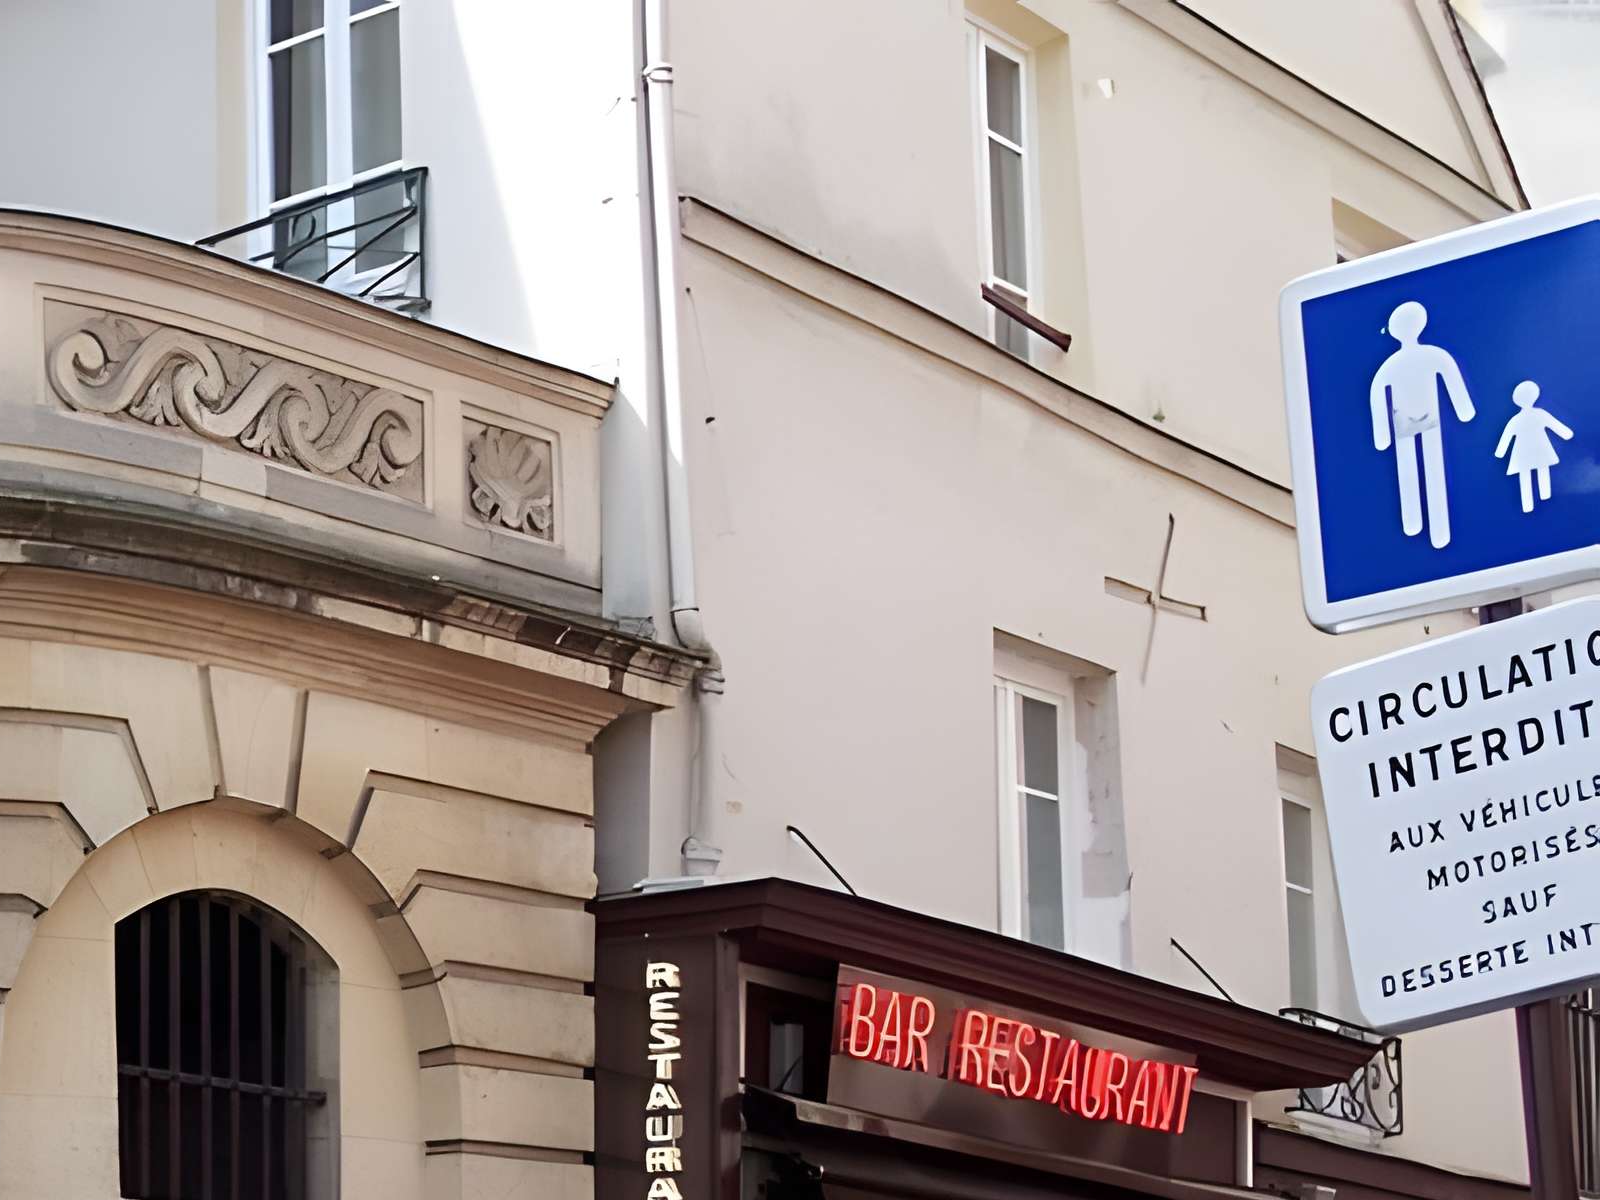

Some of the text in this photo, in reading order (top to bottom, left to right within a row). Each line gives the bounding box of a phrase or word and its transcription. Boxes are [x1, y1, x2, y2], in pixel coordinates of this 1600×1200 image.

[1389, 820, 1446, 854] AUX
[1482, 884, 1558, 925] SAUF
[1381, 939, 1529, 998] DESSERTE
[846, 981, 1200, 1135] BAR RESTAURANT
